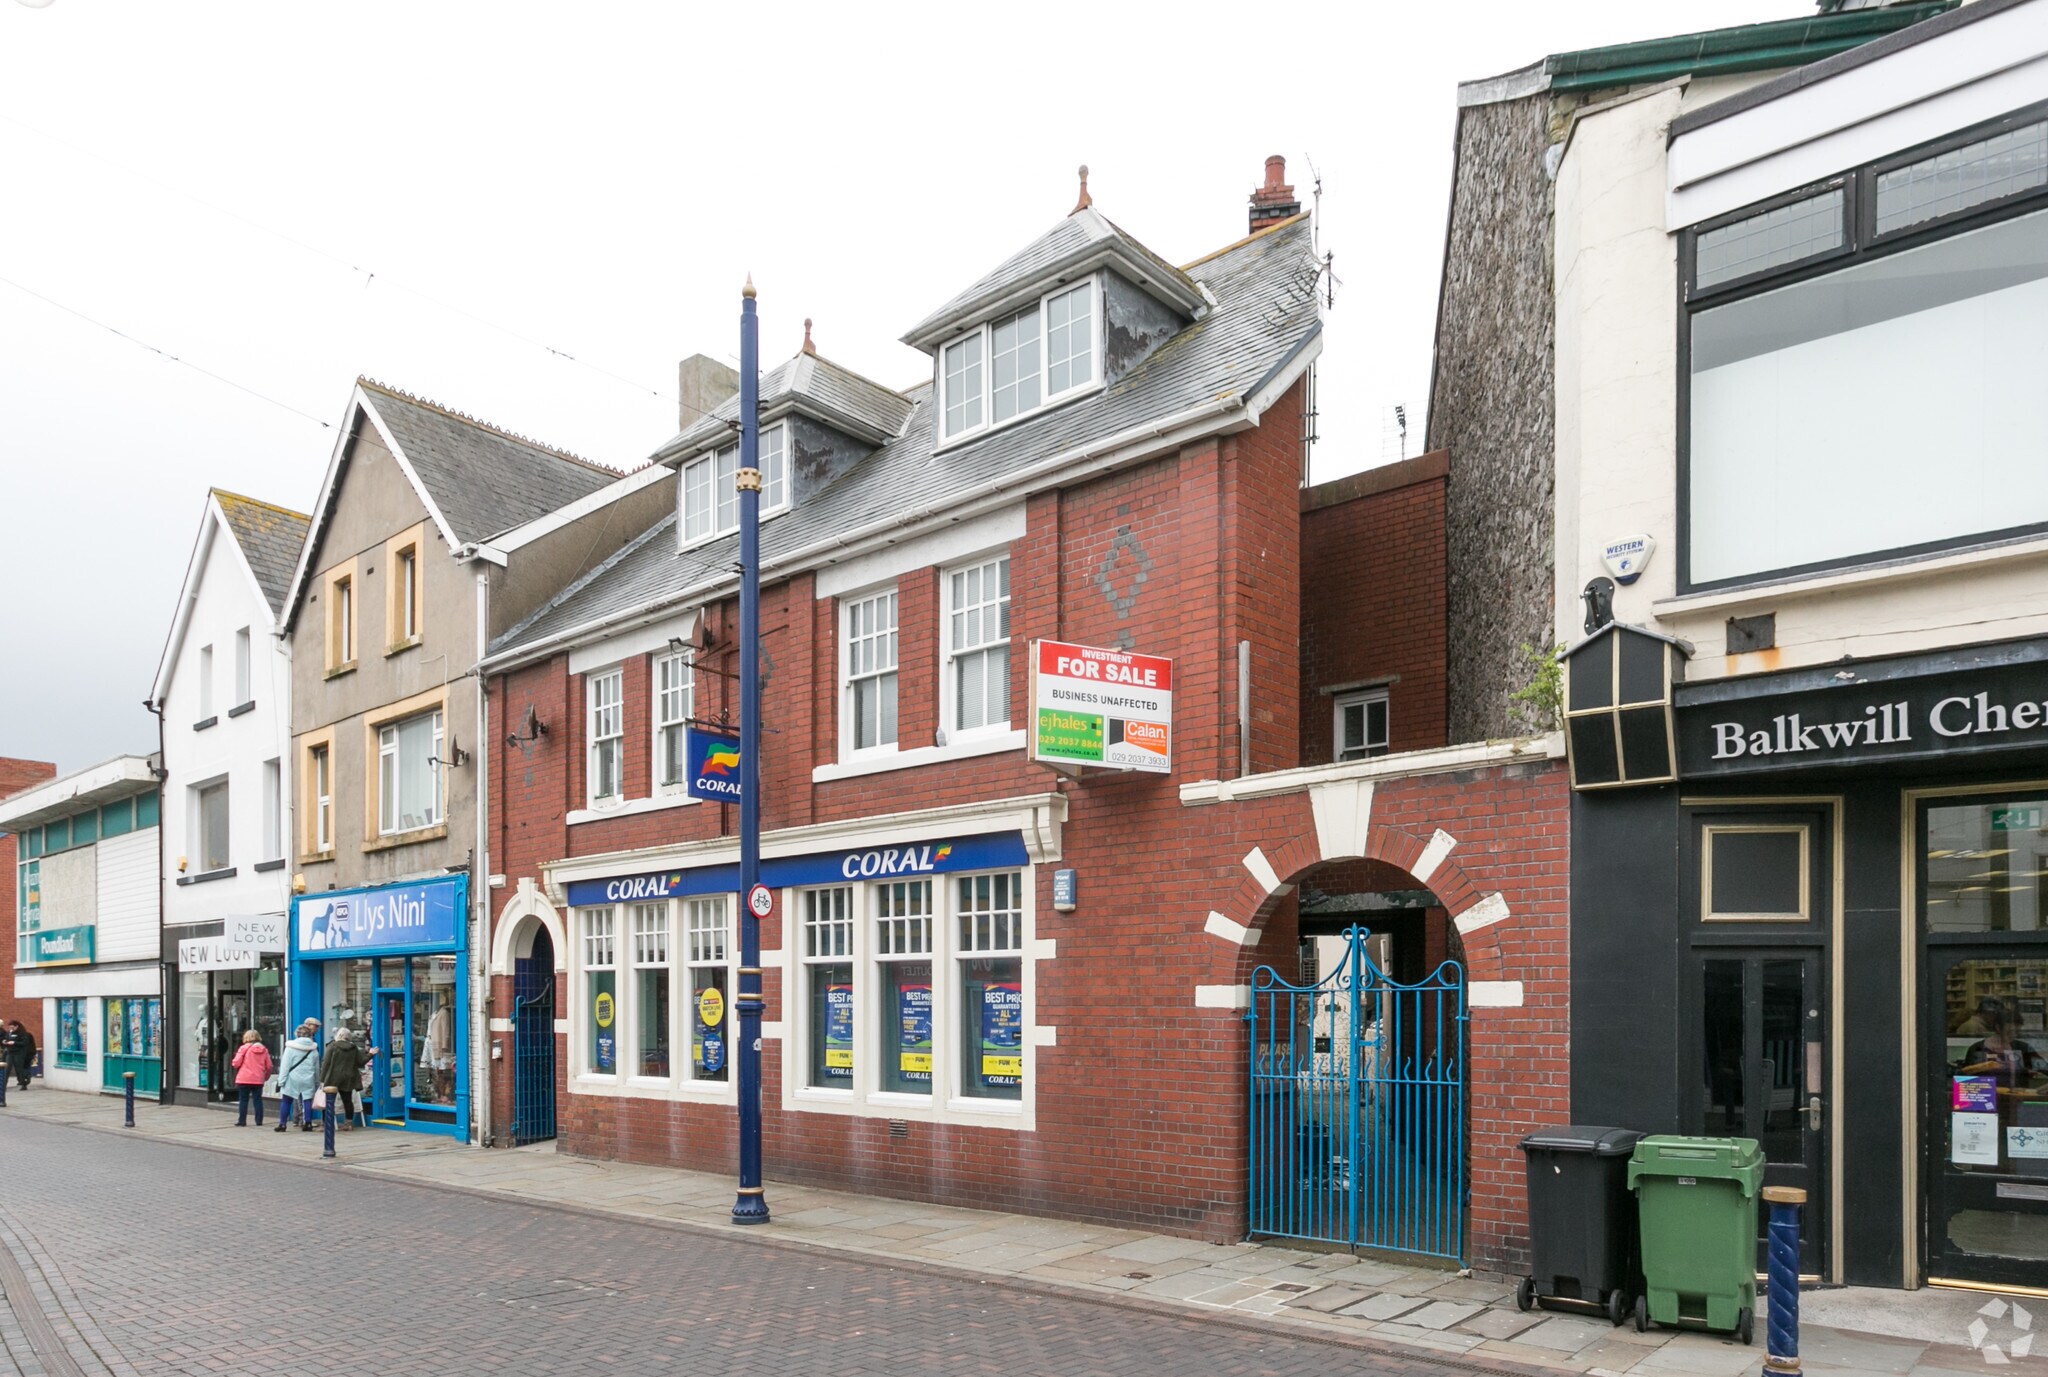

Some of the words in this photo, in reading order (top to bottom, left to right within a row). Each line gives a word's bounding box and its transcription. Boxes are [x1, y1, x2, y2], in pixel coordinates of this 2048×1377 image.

[1606, 539, 1644, 555] WESTERN
[1082, 649, 1133, 664] INVESTMENT
[1057, 656, 1100, 679] FOR
[1105, 664, 1157, 686] SALE
[1052, 689, 1099, 703] BUSINESS
[1100, 696, 1158, 711] UNAFFECTED
[1711, 701, 1912, 760] Balkwill
[1039, 735, 1055, 743] 029
[1058, 736, 1079, 746] 2037
[1112, 752, 1126, 761] 029
[1128, 755, 1146, 763] 2037
[696, 778, 742, 794] CORAL
[842, 846, 935, 878] CORAL
[606, 875, 669, 900] CORAL
[355, 900, 385, 940] Llys
[389, 892, 426, 928] Nini
[238, 923, 275, 932] NEW
[40, 932, 74, 954] Poundland
[234, 934, 278, 943] LOOK
[181, 946, 208, 964] NEW
[828, 992, 846, 1003] BEST
[907, 992, 921, 1000] BEST
[985, 992, 1005, 1003] BEST
[906, 1072, 930, 1080] CORAL
[988, 1076, 1015, 1084] CORAL
